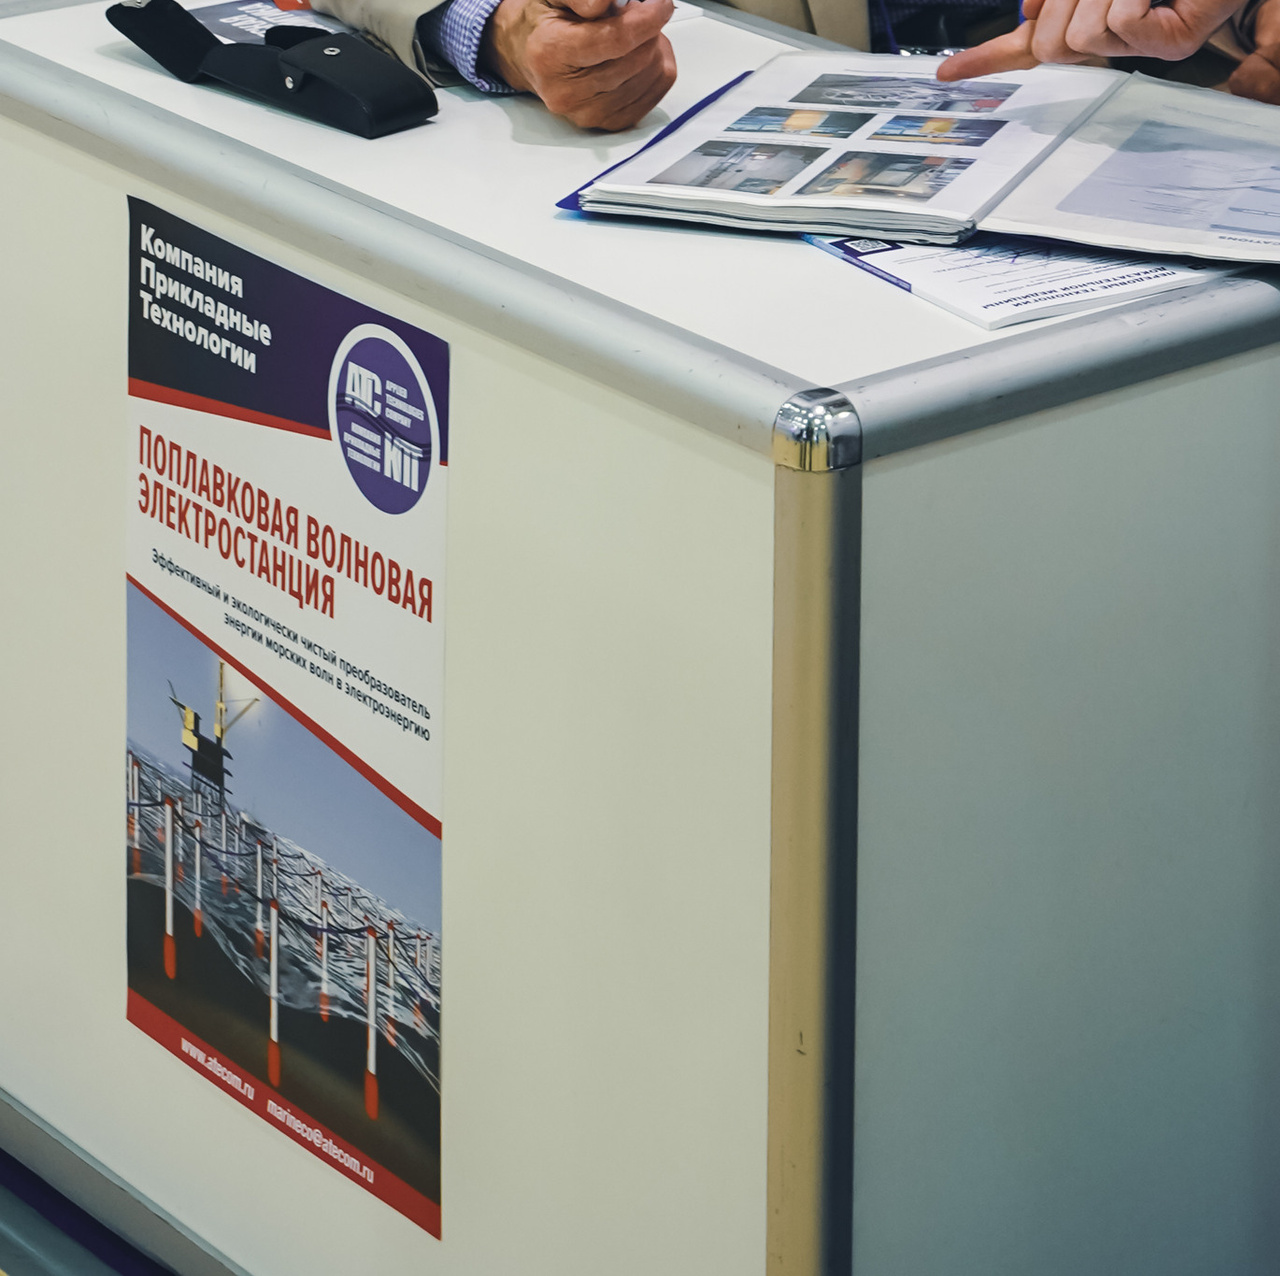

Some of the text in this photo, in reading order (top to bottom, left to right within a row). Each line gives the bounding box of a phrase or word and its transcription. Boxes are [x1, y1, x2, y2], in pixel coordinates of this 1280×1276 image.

[140, 223, 244, 298] Компания
[140, 256, 272, 347] Прикладные
[981, 289, 1058, 310] МЕДИЦИНЫ
[1013, 287, 1099, 308] ТЕХНОЛОГИИ
[1060, 266, 1168, 291] ДОКАЗАТЕЛЬНОЙ
[1102, 270, 1177, 290] ПЕРЕДОВЫЕ
[139, 290, 256, 374] Технологии
[138, 472, 335, 619] ЭЛЕКТРОСТАНЦИЯ
[139, 424, 433, 623] ПОПЛАВКОВАЯ ВОЛНОВАЯ
[152, 547, 431, 720] Эффективный и экологически чистый преобразователь
[223, 613, 430, 742] энергии морских волн в электроэнергию
[181, 1037, 374, 1184] www.atecom.ru marineco@atecom.ru
